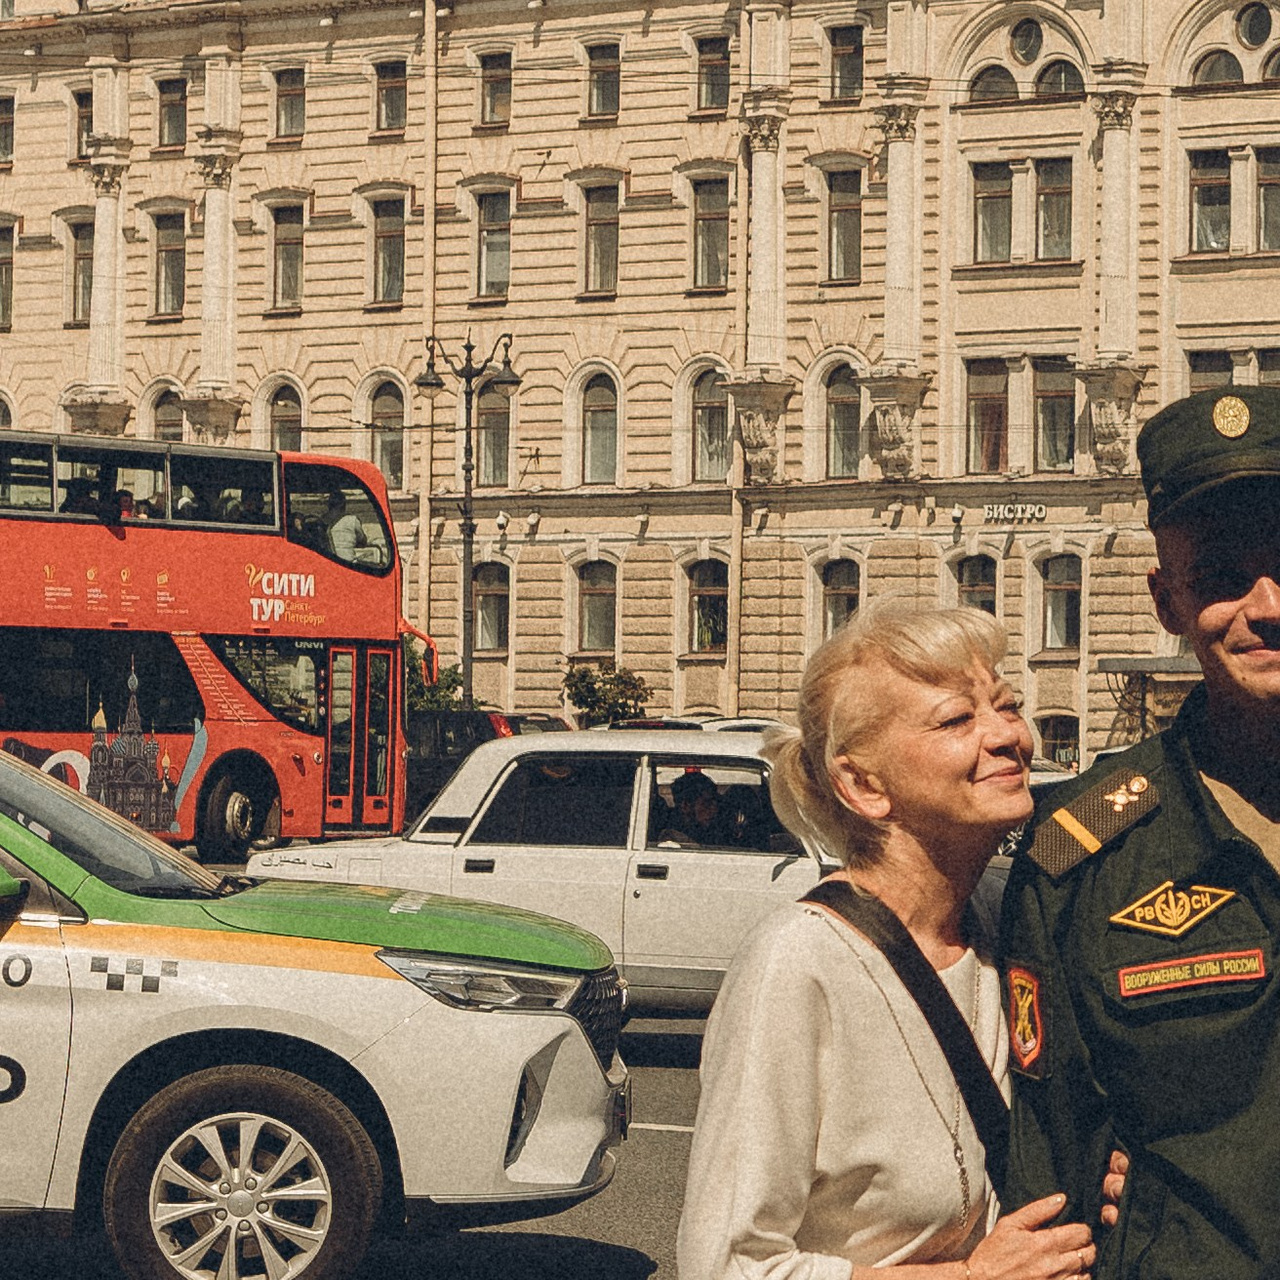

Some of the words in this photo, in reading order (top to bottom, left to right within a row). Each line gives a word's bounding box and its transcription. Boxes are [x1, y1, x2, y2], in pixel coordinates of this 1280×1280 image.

[983, 503, 1046, 519] БИСТРО
[261, 571, 315, 597] СИТИ
[249, 597, 285, 622] ТУР
[284, 599, 311, 611] Санкт-
[284, 610, 326, 627] Петербург
[1134, 905, 1155, 922] РВ
[1190, 892, 1211, 909] СН
[1124, 965, 1192, 990] ВООРУЖЕННЫЕ
[1194, 961, 1220, 978] СИЛЫ
[1223, 957, 1260, 974] РОССИИ
